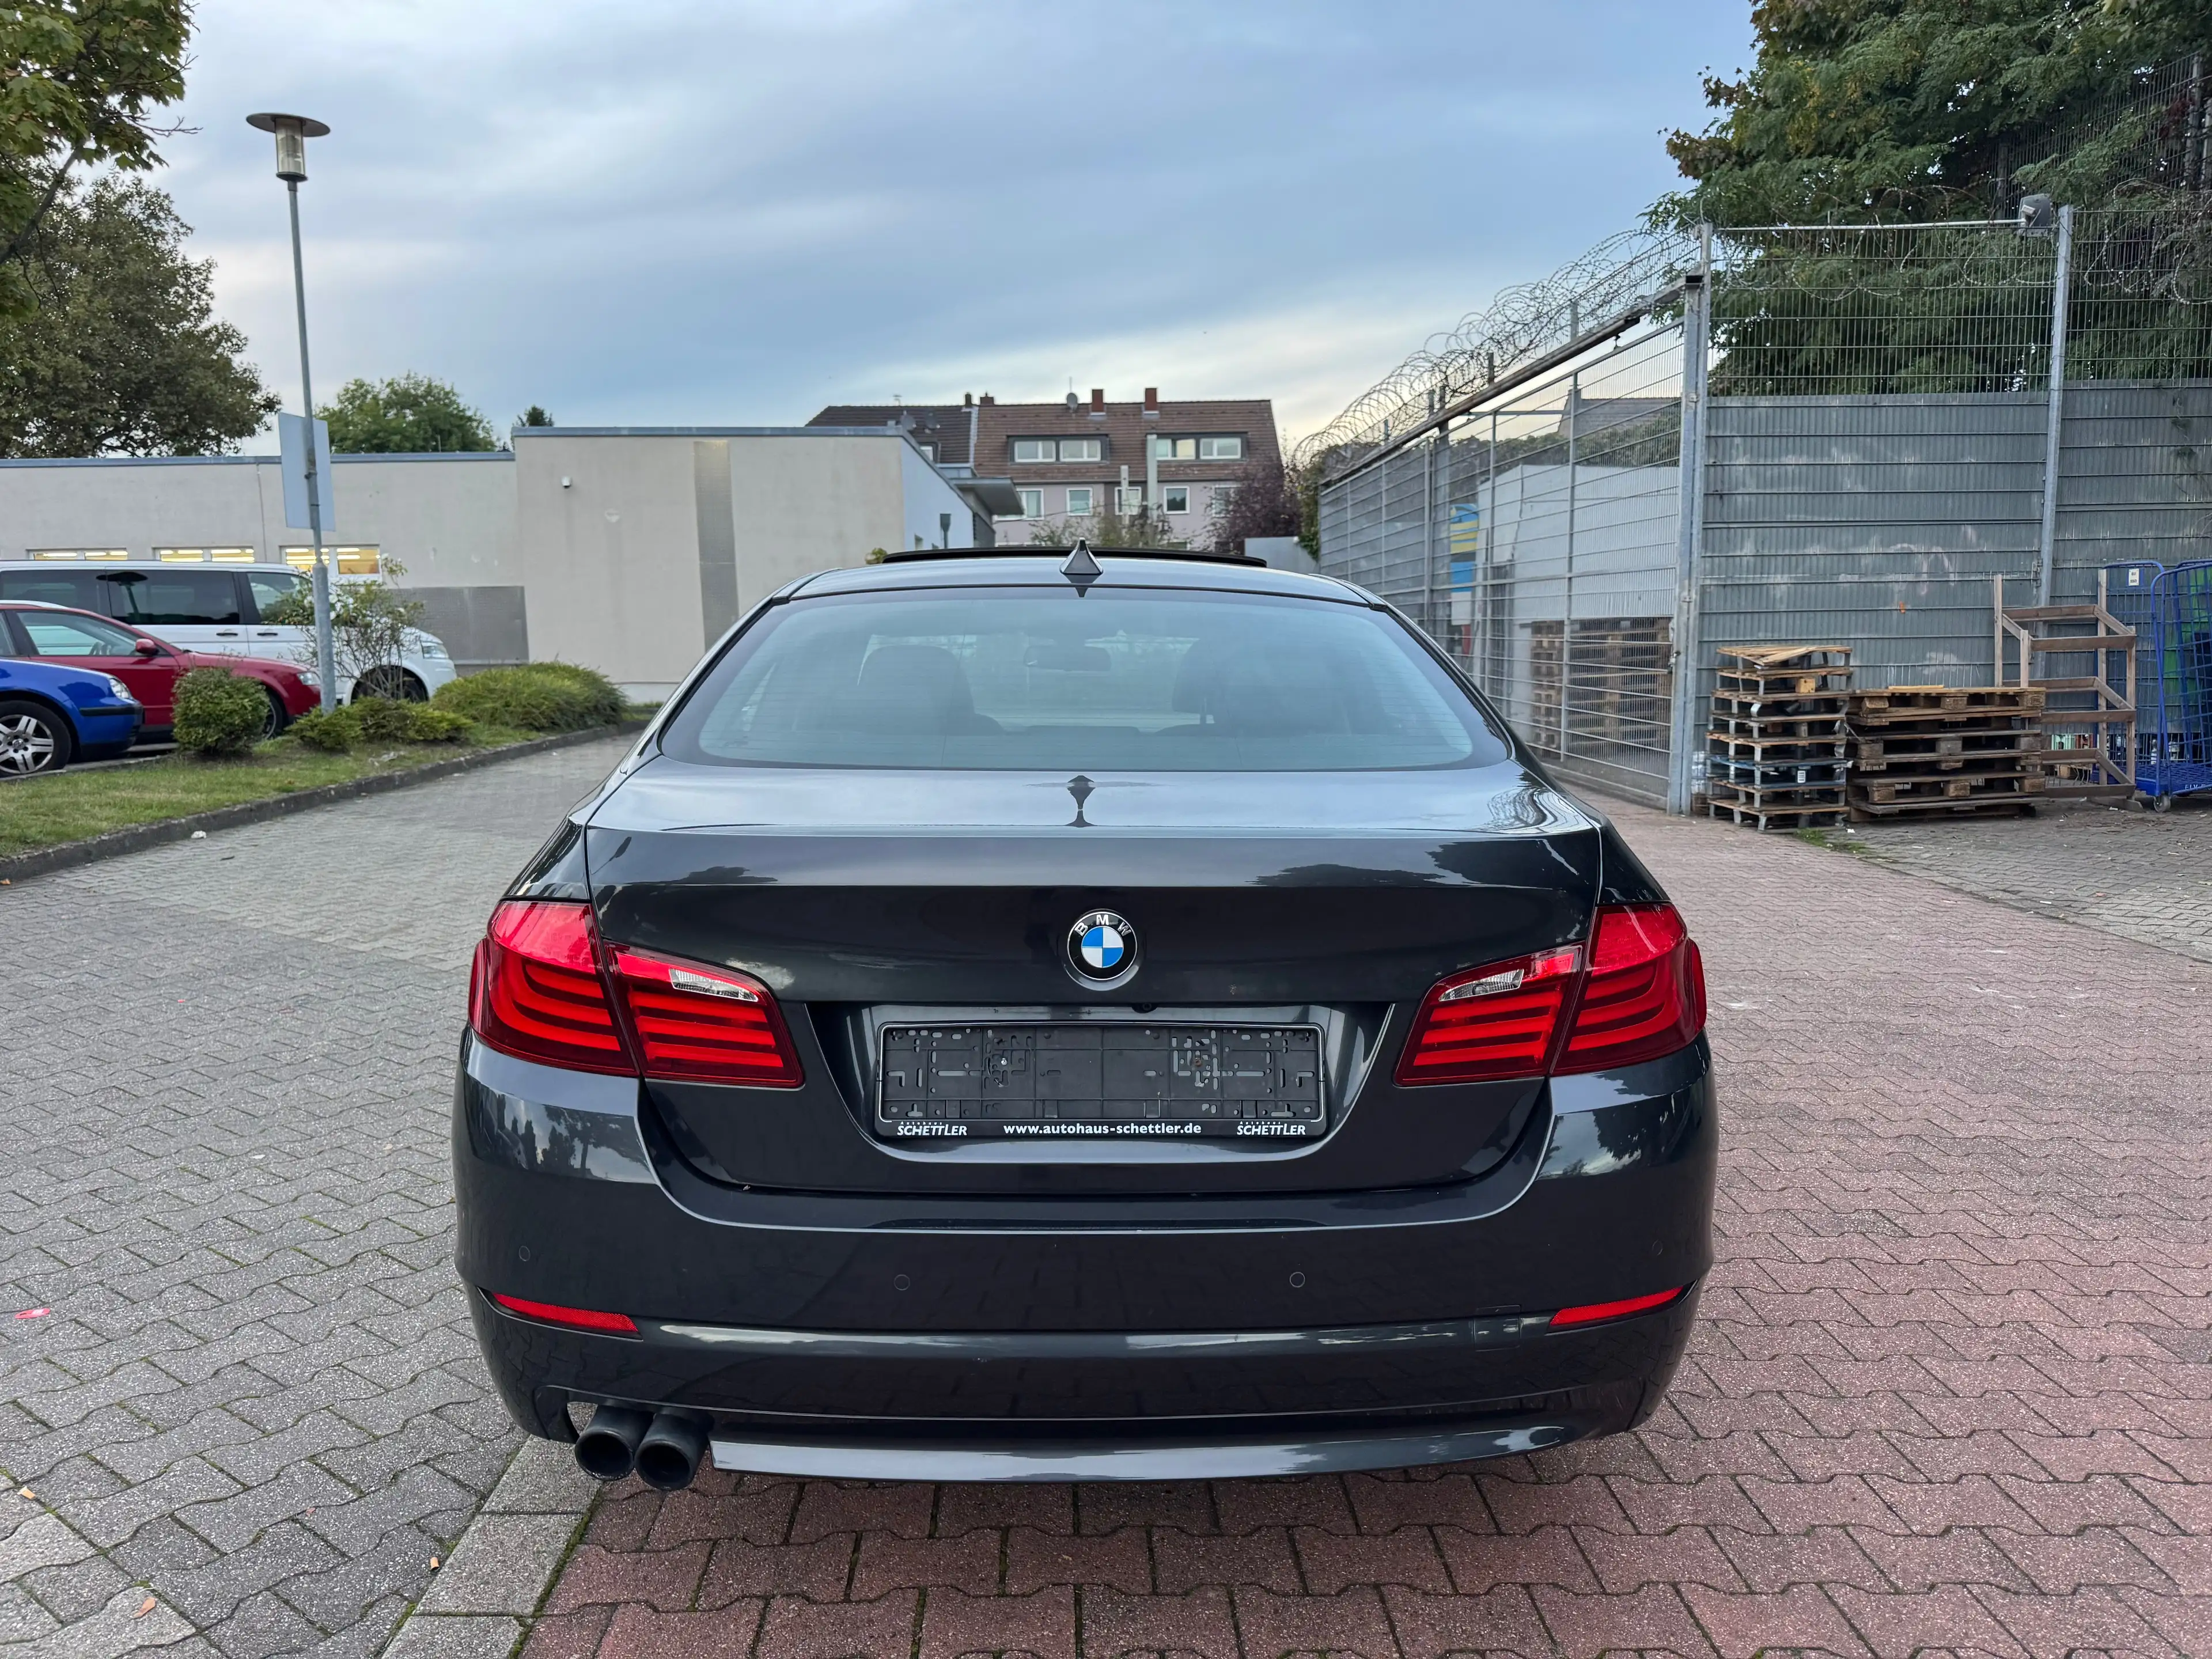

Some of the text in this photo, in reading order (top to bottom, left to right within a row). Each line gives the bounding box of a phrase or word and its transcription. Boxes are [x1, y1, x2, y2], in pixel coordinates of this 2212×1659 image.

[1074, 914, 1131, 936] BMW
[897, 1124, 967, 1136] SCHETTLER
[1003, 1123, 1202, 1134] www.autohaus-schettler.de
[1237, 1123, 1306, 1135] SCHETTLER
